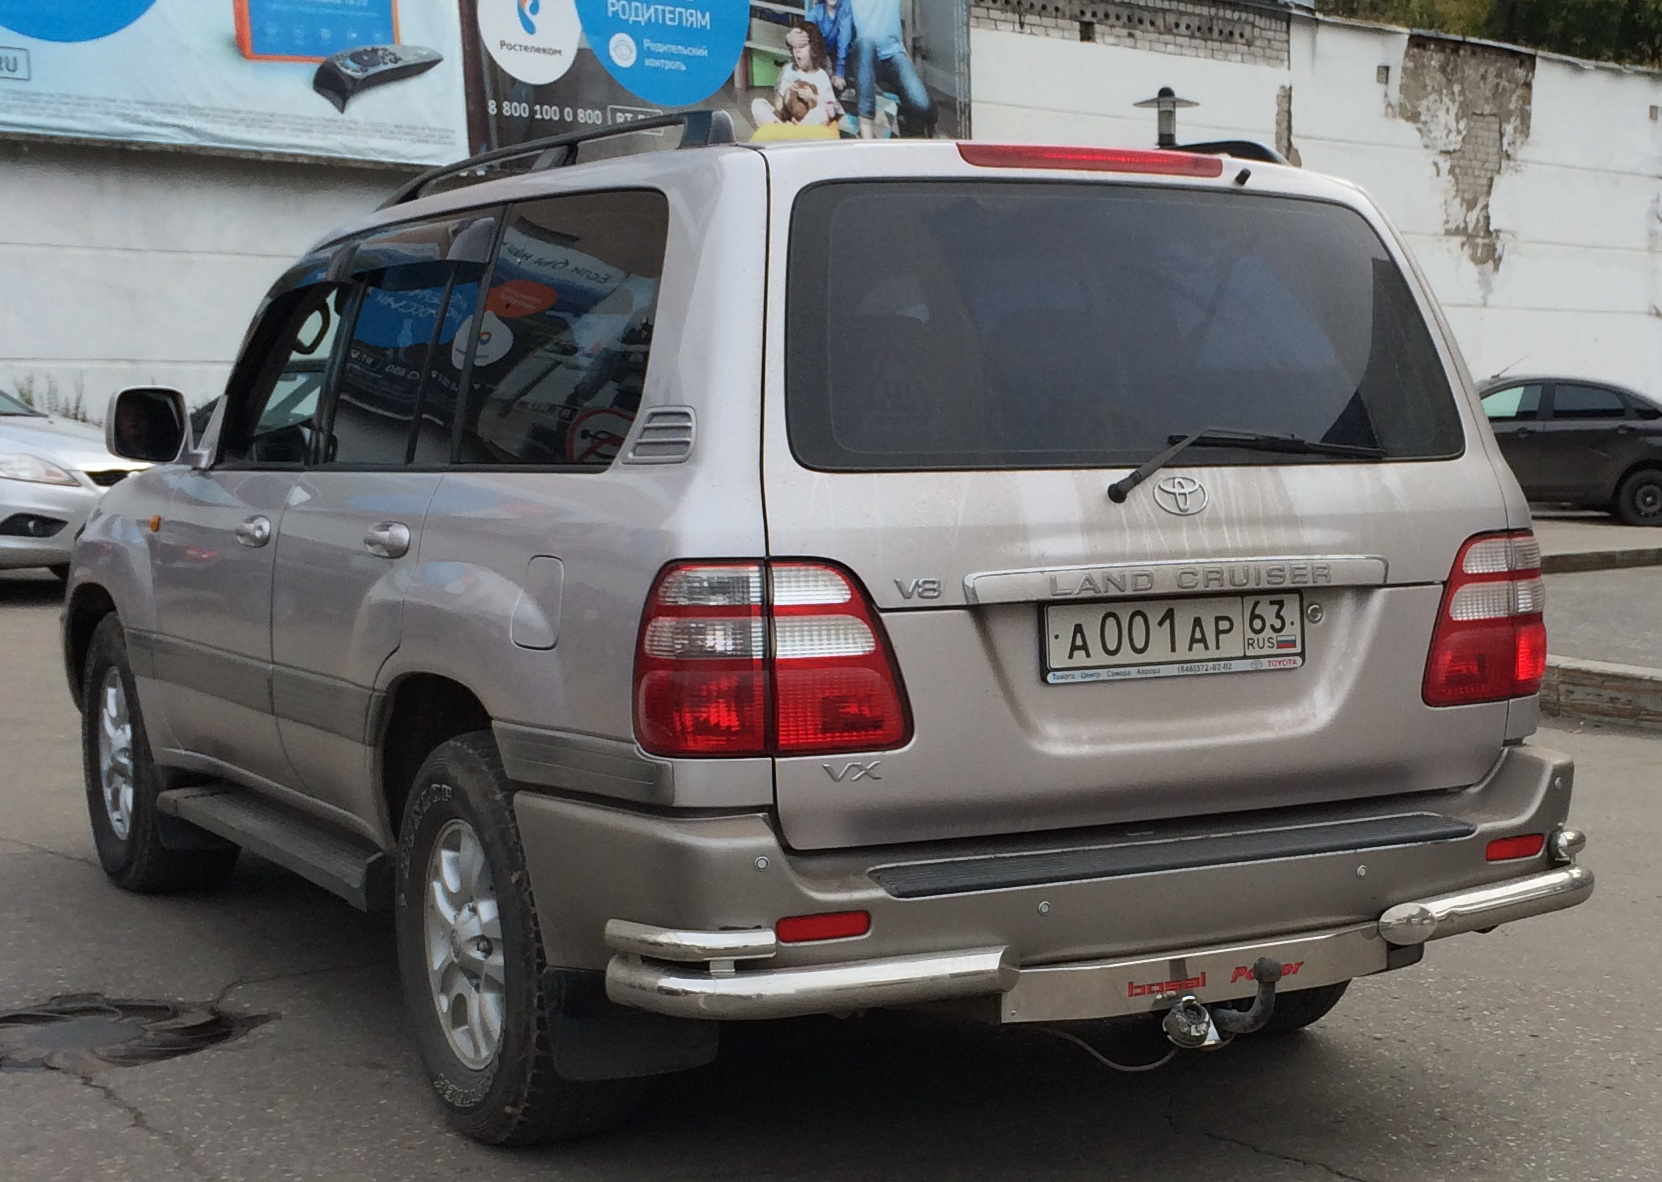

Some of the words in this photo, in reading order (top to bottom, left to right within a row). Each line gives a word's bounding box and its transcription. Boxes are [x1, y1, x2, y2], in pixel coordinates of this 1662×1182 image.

[607, 0, 711, 30] РОДИТЕЛЯМ
[499, 39, 562, 56] Ростелеком
[643, 39, 708, 57] Родительский
[644, 58, 687, 71] контроль
[488, 99, 498, 115] 8
[502, 101, 530, 118] 800
[534, 105, 560, 121] 100
[563, 107, 574, 122] 0
[577, 109, 603, 125] 800
[893, 578, 943, 600] V8
[1049, 569, 1154, 596] LAND
[1176, 563, 1332, 589] CRUISER
[1248, 599, 1286, 635] 63
[1246, 636, 1275, 650] RUS
[1266, 659, 1298, 668] TOYOTA
[821, 760, 882, 782] VX
[1127, 971, 1206, 997] bosal
